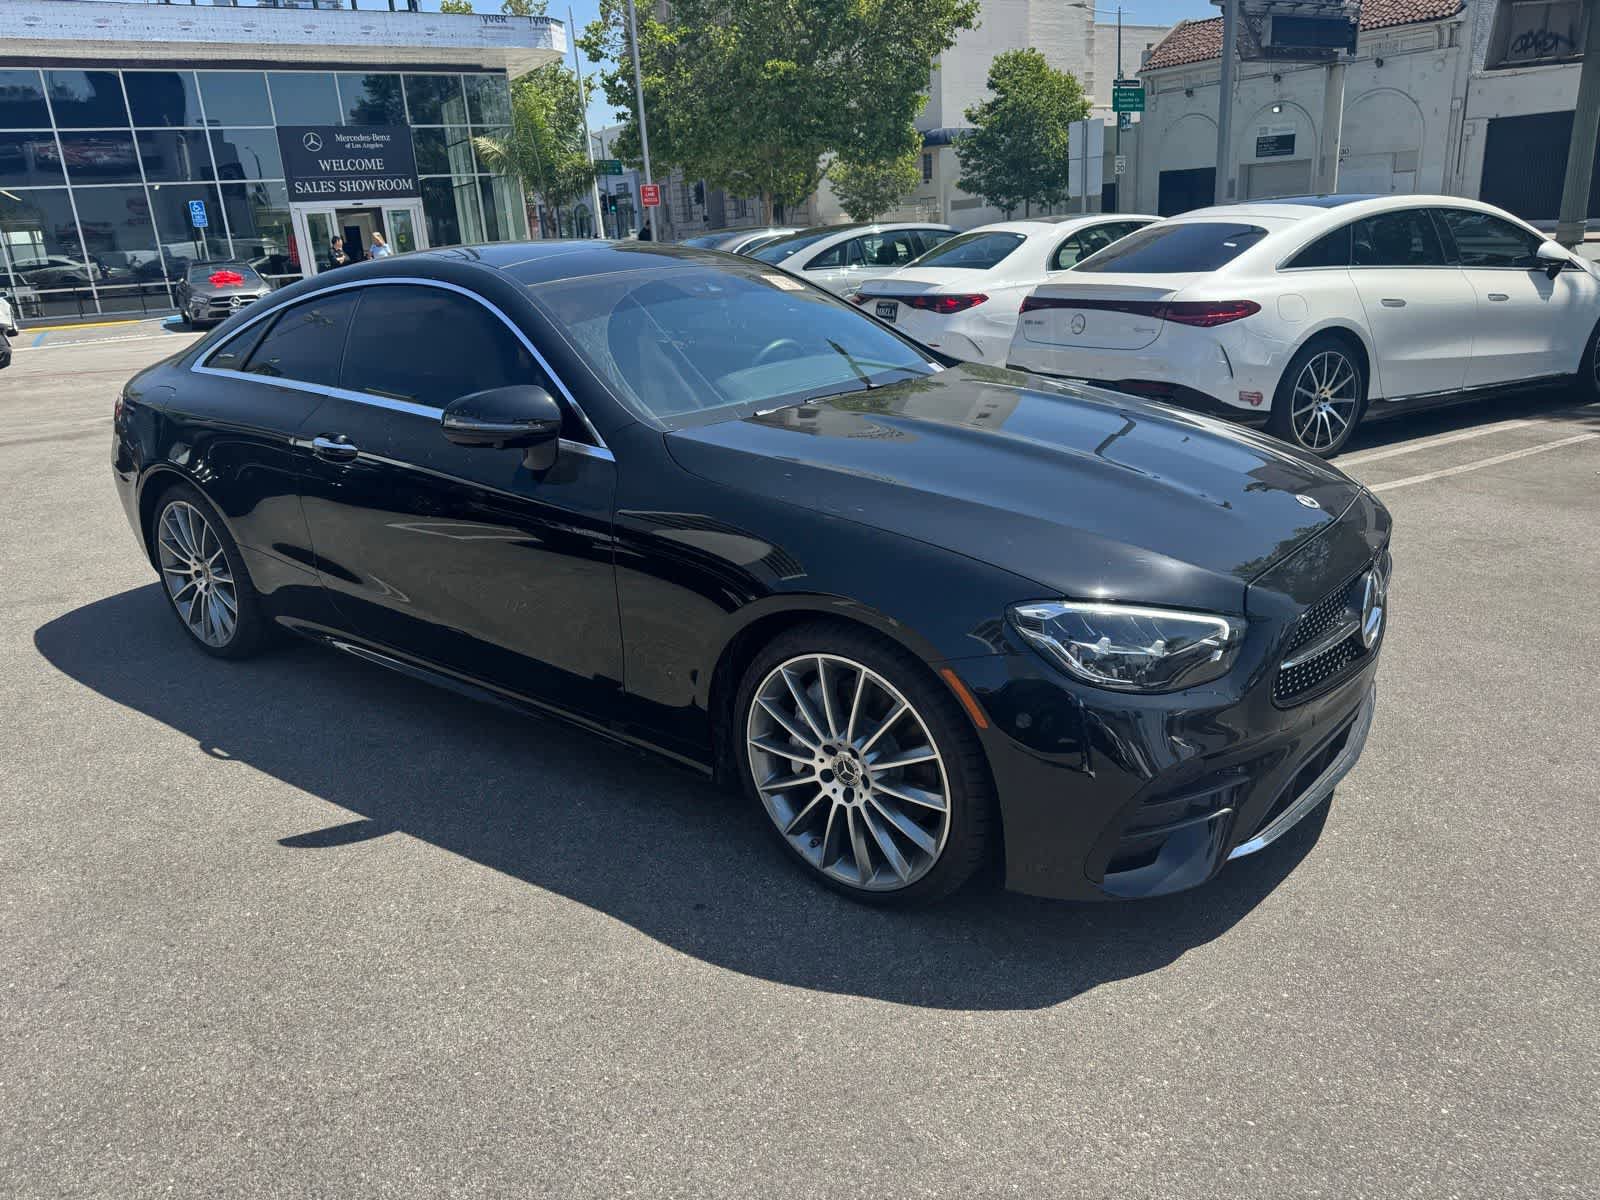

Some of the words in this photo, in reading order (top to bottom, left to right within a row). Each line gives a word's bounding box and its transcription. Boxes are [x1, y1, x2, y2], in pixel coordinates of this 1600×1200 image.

[335, 133, 391, 142] Mercedes-Benz
[318, 158, 385, 172] WELCOME
[295, 180, 336, 194] SALES
[339, 178, 414, 192] SHOWROOM
